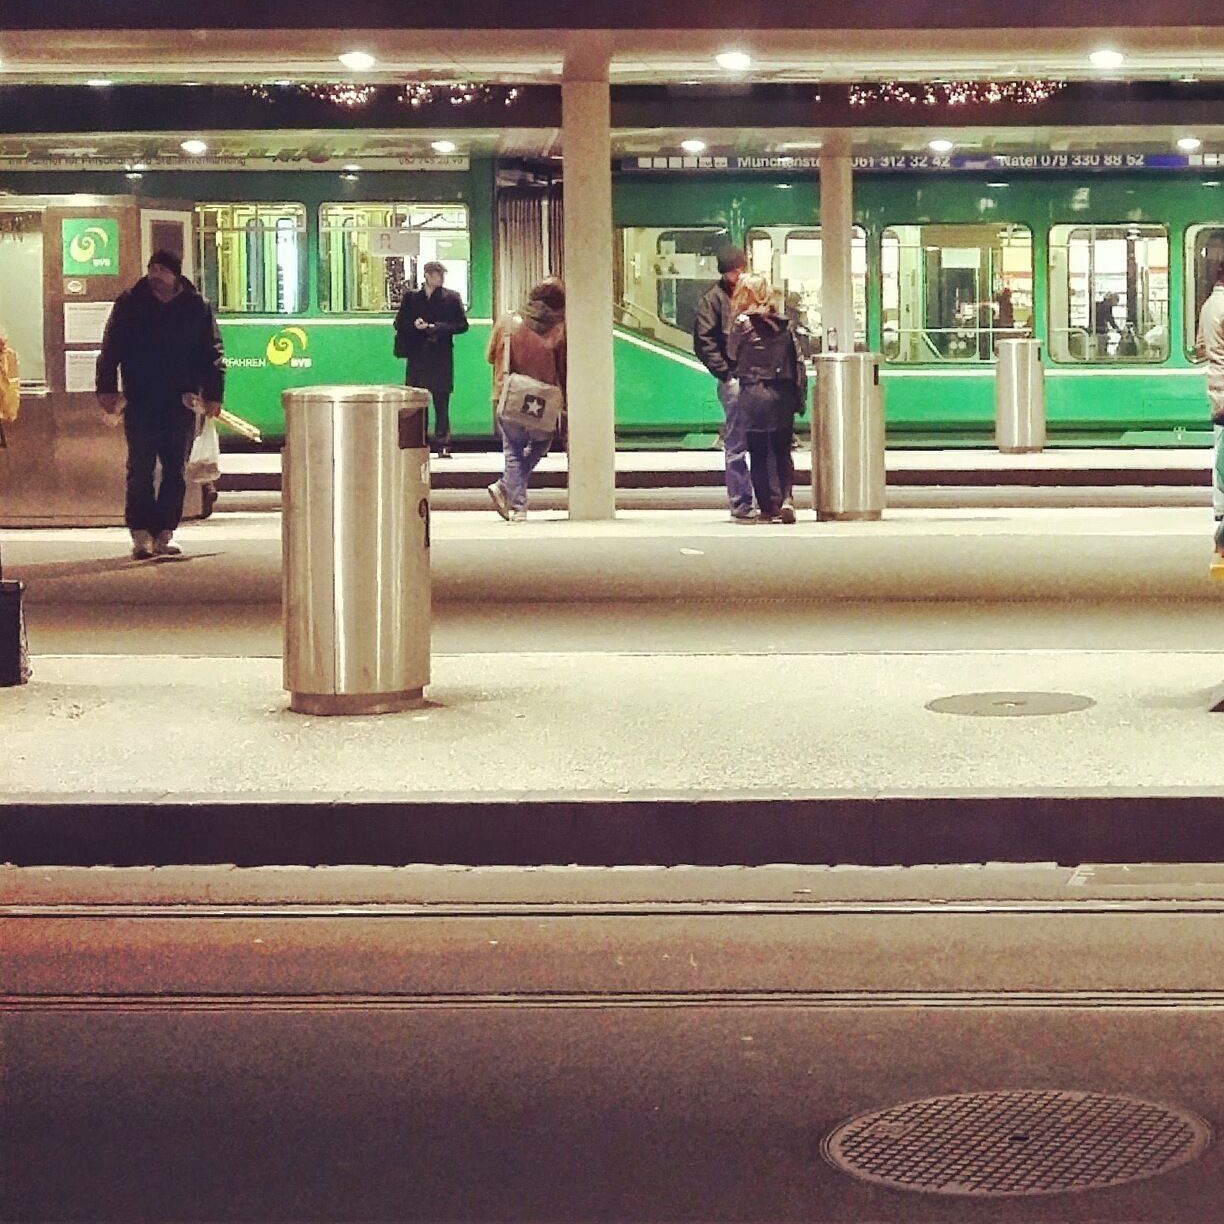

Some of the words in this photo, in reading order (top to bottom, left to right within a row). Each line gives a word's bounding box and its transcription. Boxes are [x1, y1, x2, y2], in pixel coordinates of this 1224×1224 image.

[910, 156, 928, 168] 32
[932, 155, 950, 168] 42
[1001, 155, 1037, 167] Natel
[1071, 155, 1099, 167] 330
